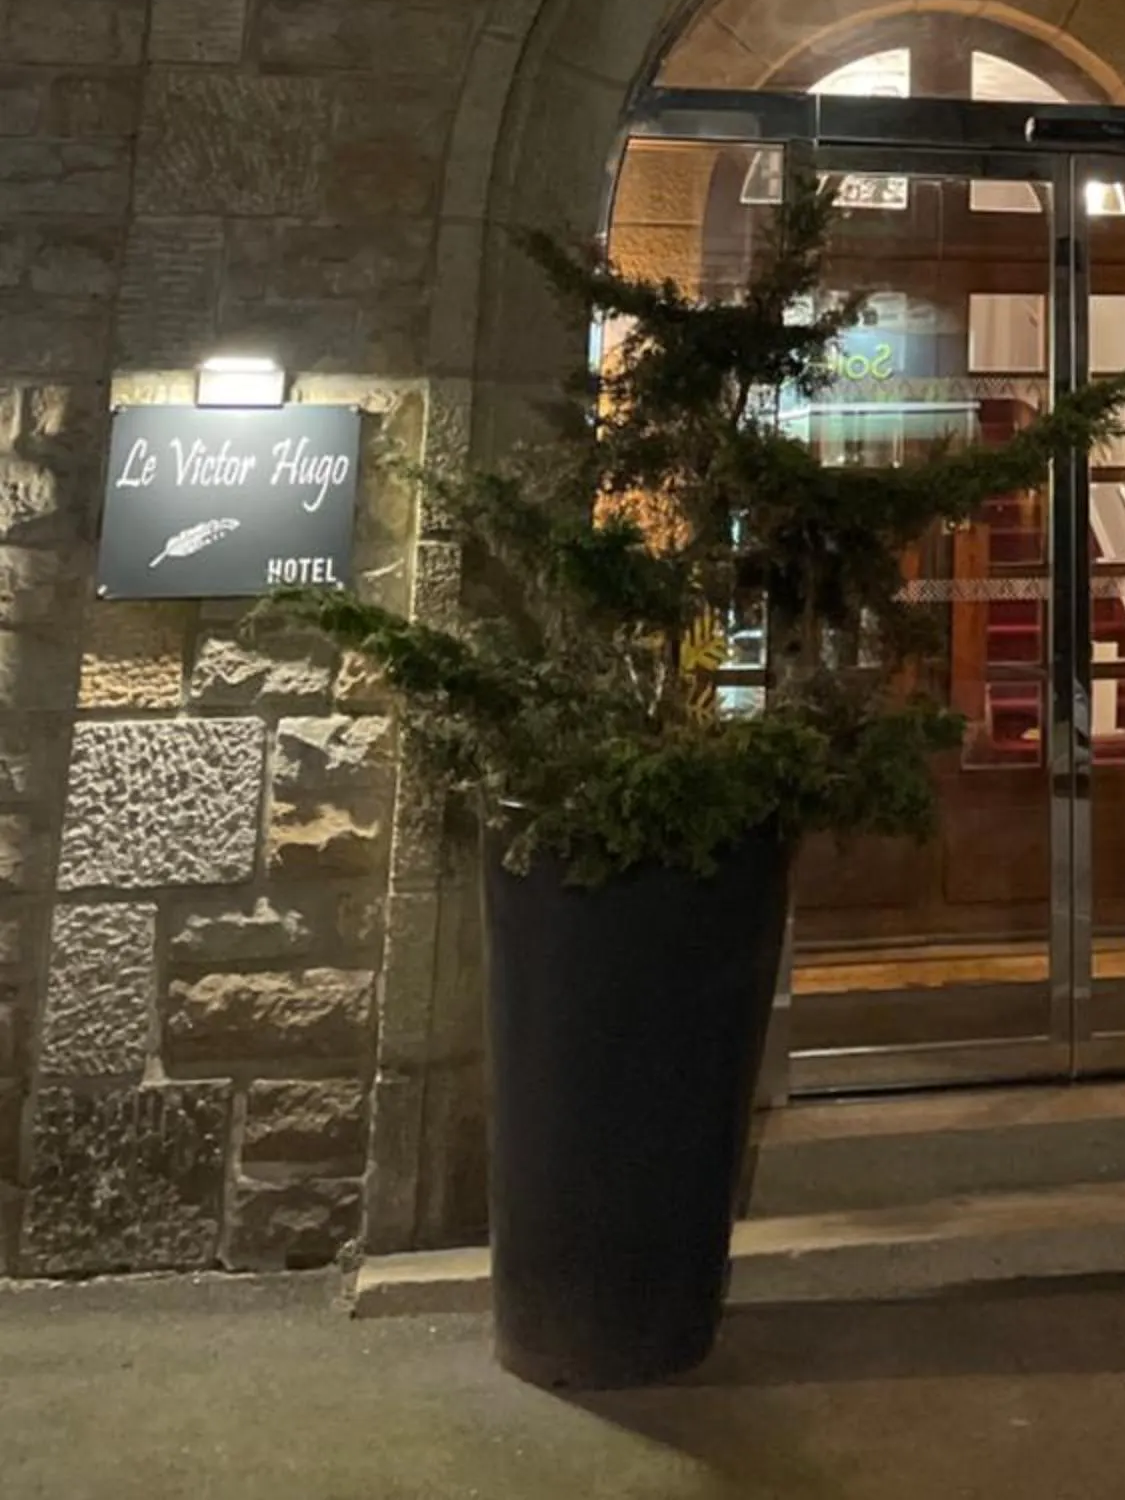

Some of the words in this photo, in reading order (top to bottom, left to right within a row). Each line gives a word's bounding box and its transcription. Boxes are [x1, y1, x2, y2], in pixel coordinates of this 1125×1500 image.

[115, 437, 157, 488] Le
[170, 436, 257, 486] Victor
[270, 436, 350, 513] Hugo
[267, 557, 337, 584] HOTEL
